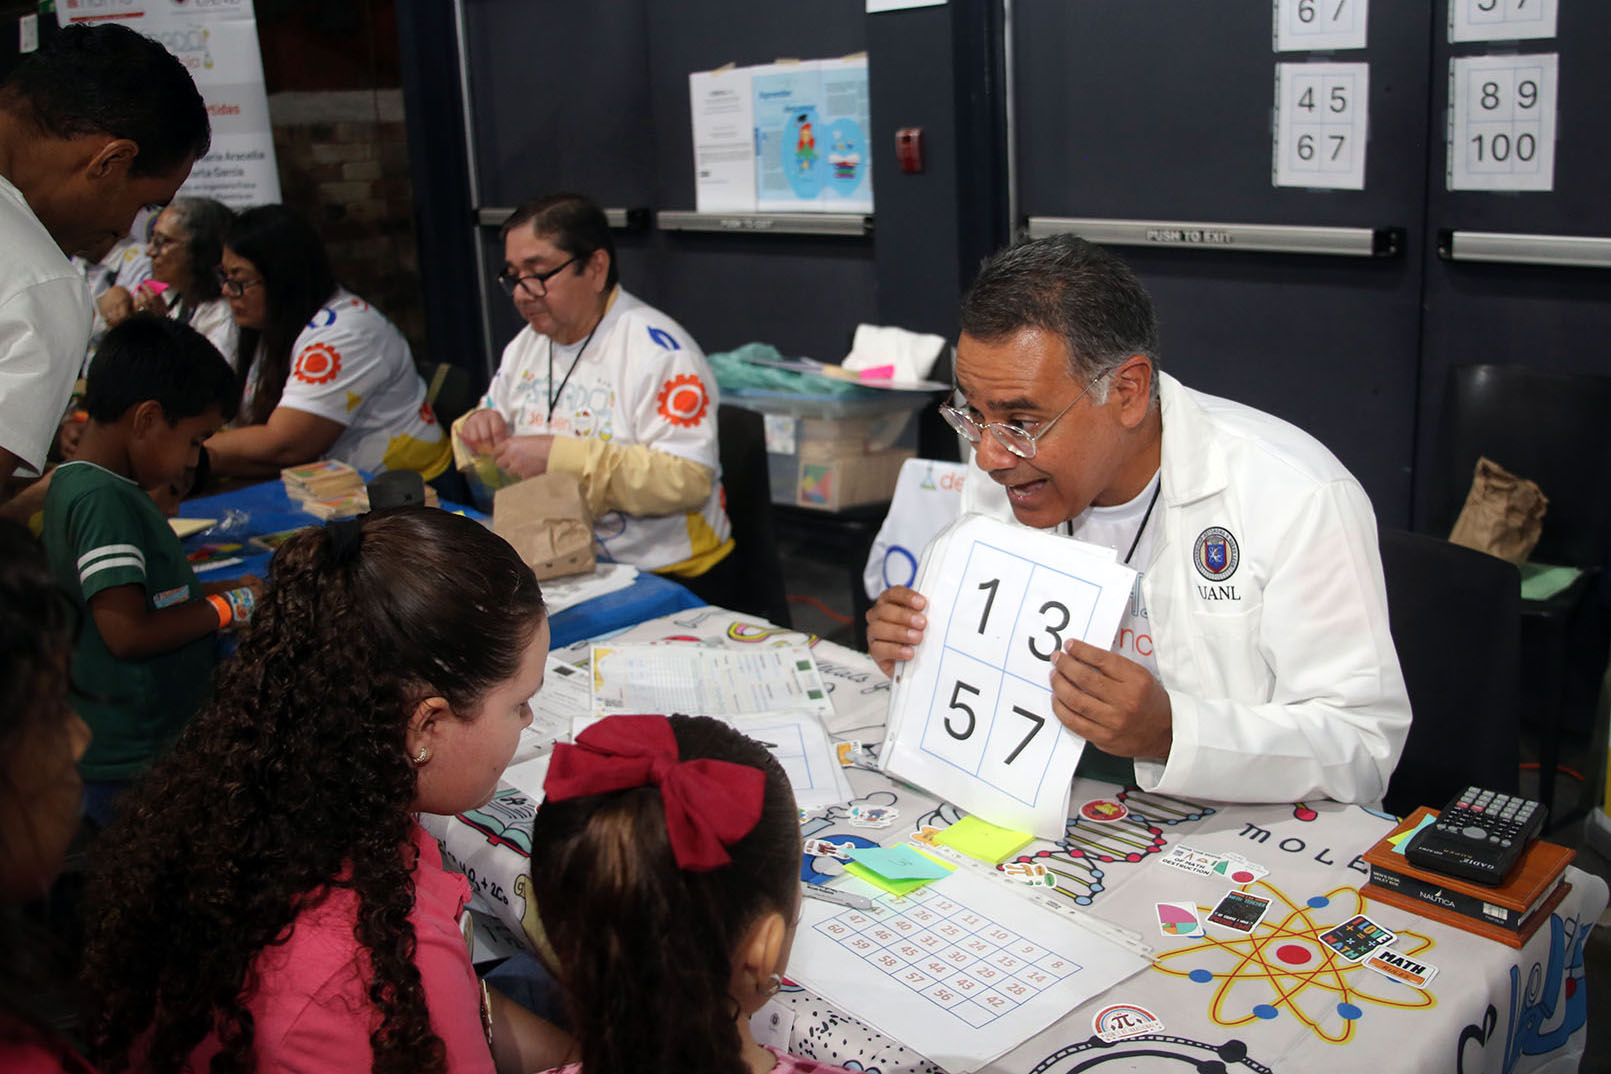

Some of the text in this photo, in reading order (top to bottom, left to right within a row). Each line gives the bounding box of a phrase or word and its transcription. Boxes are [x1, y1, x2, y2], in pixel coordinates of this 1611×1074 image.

[1298, 86, 1347, 113] 4 5
[1481, 80, 1538, 110] 8 9
[1297, 134, 1345, 161] 6 7
[1471, 132, 1536, 162] 100
[1146, 229, 1233, 245] PUSH TO EXIT
[1198, 585, 1242, 601] UANL
[977, 578, 1071, 662] 1 3
[943, 679, 1046, 766] 5 7
[1162, 858, 1211, 876] DESTRUCTION
[1419, 890, 1456, 909] NAUTICA
[936, 901, 953, 911] 12
[962, 914, 980, 926] 11
[990, 929, 1009, 941] 10
[1021, 946, 1035, 954] 9
[1050, 961, 1065, 970] 8
[1357, 921, 1392, 943] LOVE
[896, 920, 913, 931] 40
[920, 935, 939, 947] 31
[948, 951, 967, 963] 30
[976, 966, 996, 979] 29
[1006, 982, 1027, 996] 28
[914, 910, 933, 921] 26
[940, 925, 960, 936] 25
[968, 941, 987, 952] 24
[998, 955, 1017, 968] 15
[1027, 971, 1048, 983] 14
[1323, 935, 1360, 959] MATH
[827, 922, 954, 1001] 60 59 58 57 56
[849, 914, 1006, 1008] 47 46 45 44 43 42
[1378, 951, 1427, 975] MATH
